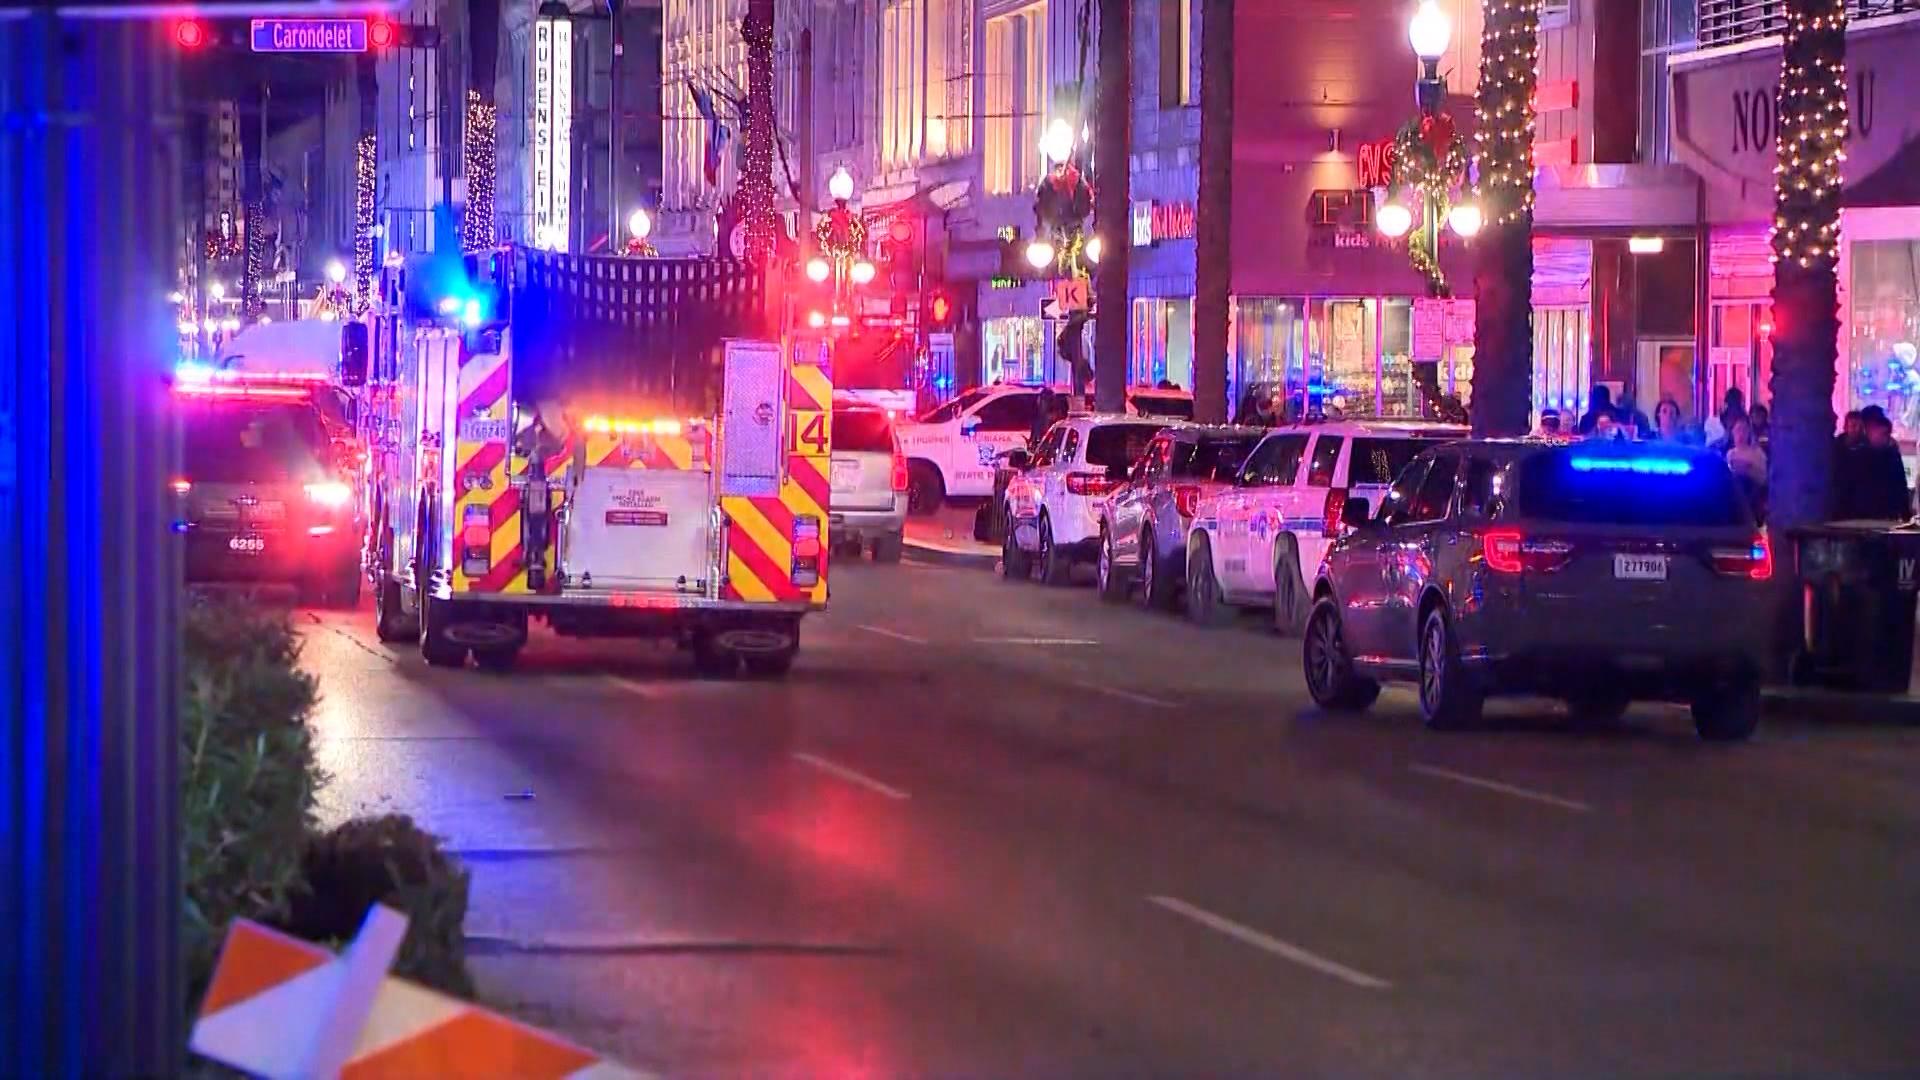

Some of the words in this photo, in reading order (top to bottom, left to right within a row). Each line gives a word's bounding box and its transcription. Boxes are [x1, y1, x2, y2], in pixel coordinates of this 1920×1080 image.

[273, 22, 352, 49] Carondelet
[1335, 233, 1369, 248] kids
[1064, 286, 1079, 304] K
[790, 412, 829, 454] 14
